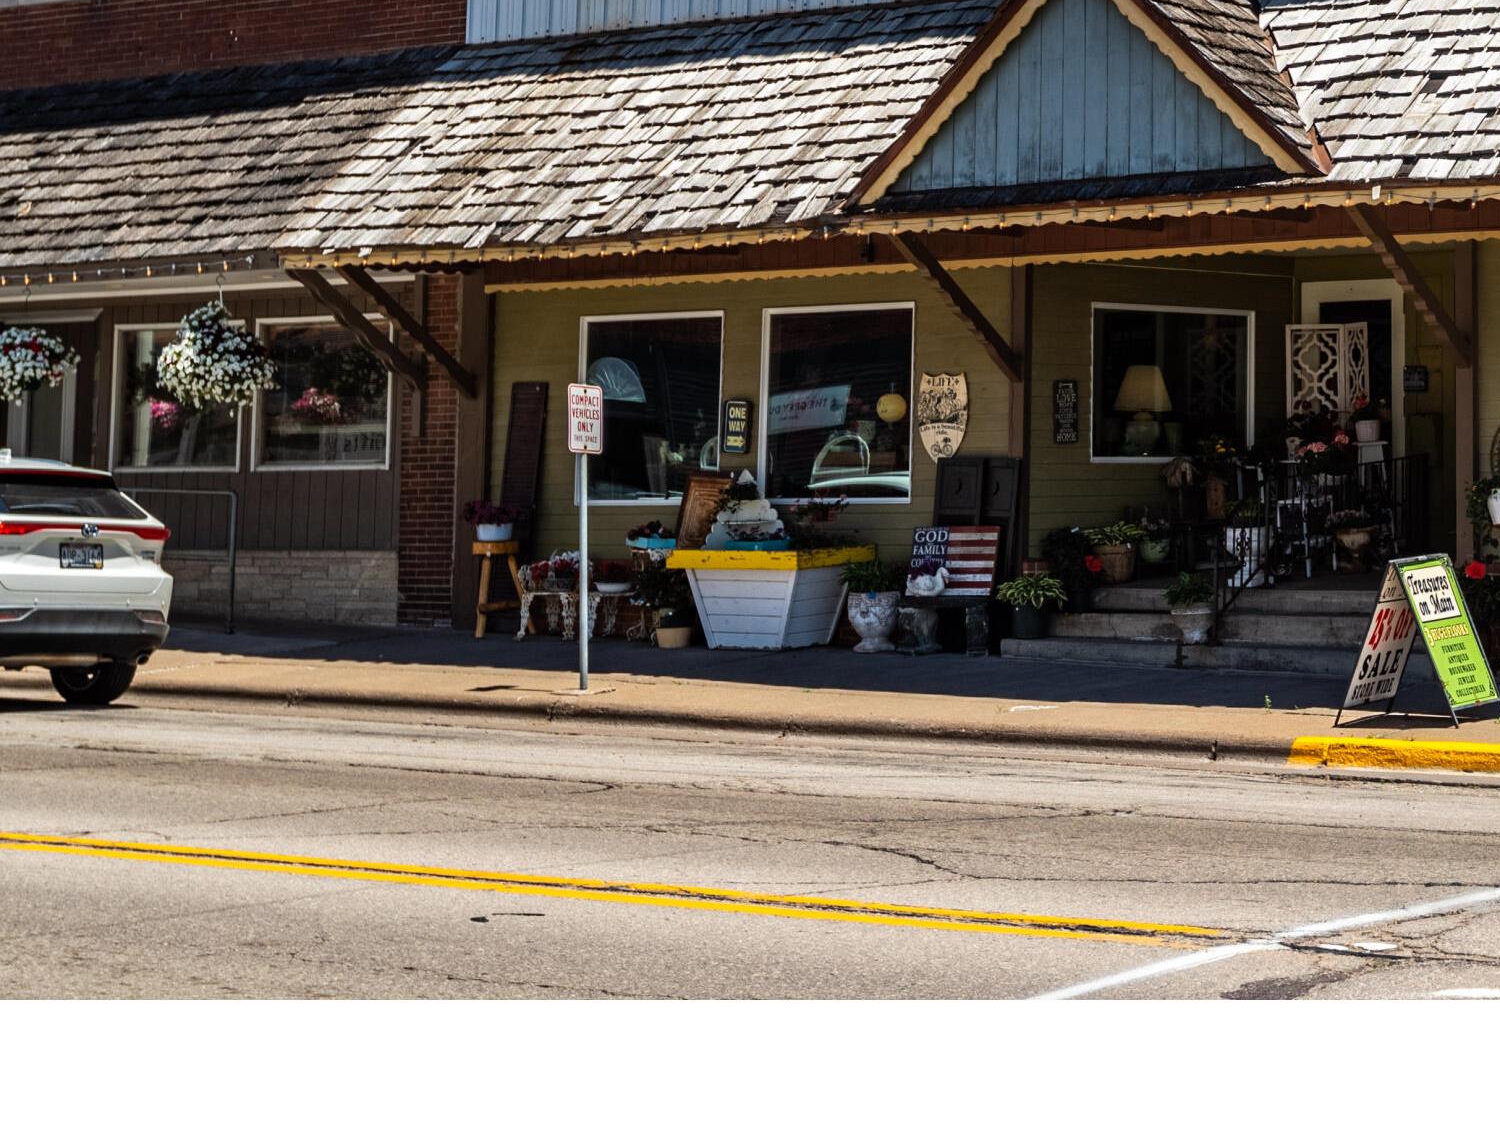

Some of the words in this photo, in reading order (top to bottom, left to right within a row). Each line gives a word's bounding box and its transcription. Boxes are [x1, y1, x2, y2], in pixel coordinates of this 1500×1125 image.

[931, 377, 955, 387] LIFE
[571, 394, 599, 407] COMPACT
[571, 408, 600, 421] VEHICLES
[729, 406, 747, 419] ONE
[577, 421, 594, 433] ONLY
[728, 420, 746, 433] WAY
[573, 434, 583, 443] THIS
[584, 435, 598, 444] SPACE
[914, 530, 948, 543] GOD
[912, 545, 946, 555] FAMILY
[1406, 573, 1449, 595] Treasures
[1418, 600, 1431, 616] on
[1430, 591, 1455, 615] Main
[1368, 607, 1397, 651] 25%
[1393, 606, 1414, 641] OFF
[1441, 642, 1466, 654] FURNITURE
[1358, 648, 1404, 680] SALE
[1448, 653, 1469, 664] ANTIQUES
[1448, 663, 1477, 675] HOUSEWARES
[1457, 675, 1476, 685] JEWELRY
[1351, 680, 1375, 700] STORE
[1375, 677, 1395, 694] WIDE
[1455, 684, 1486, 698] COLLECTIBLES
